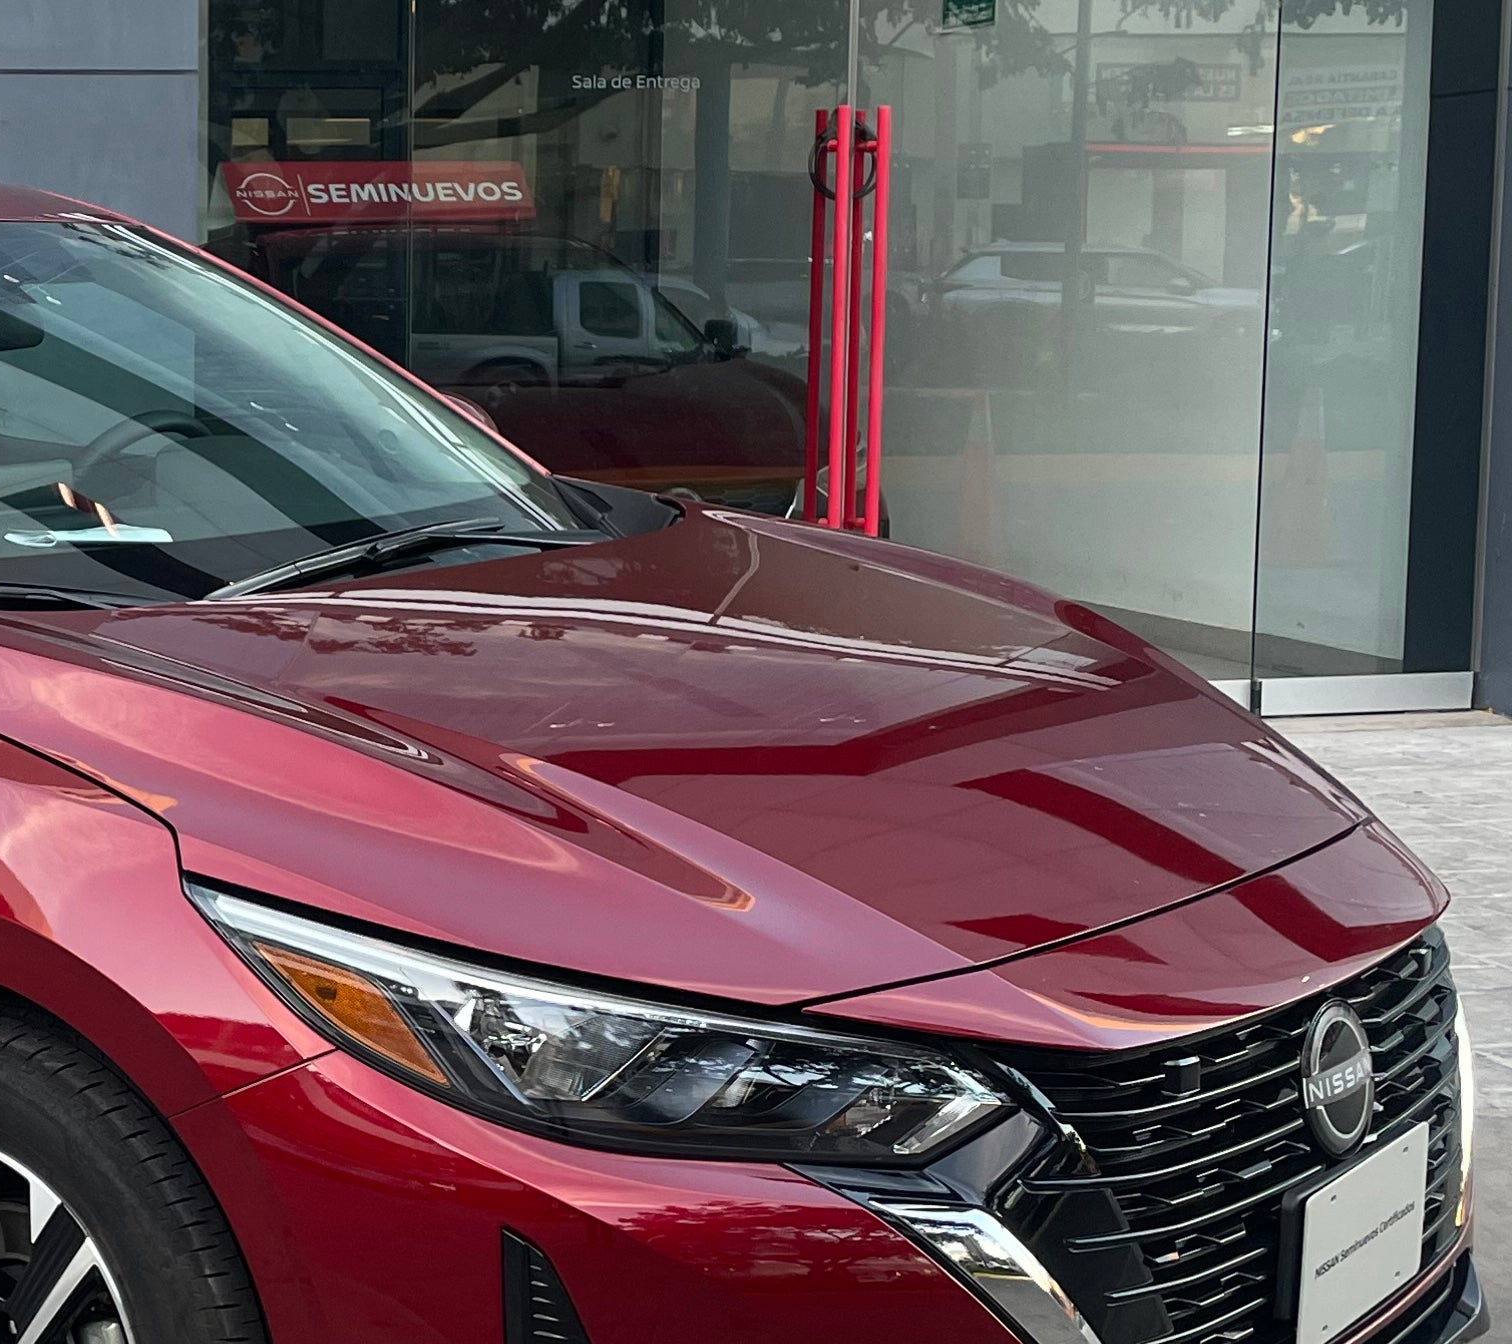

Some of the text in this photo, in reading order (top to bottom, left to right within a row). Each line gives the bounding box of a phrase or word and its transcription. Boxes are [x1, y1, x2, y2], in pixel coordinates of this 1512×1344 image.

[571, 74, 701, 93] Sala de Entrega
[236, 181, 524, 204] NISSAN SEMINUEVOS
